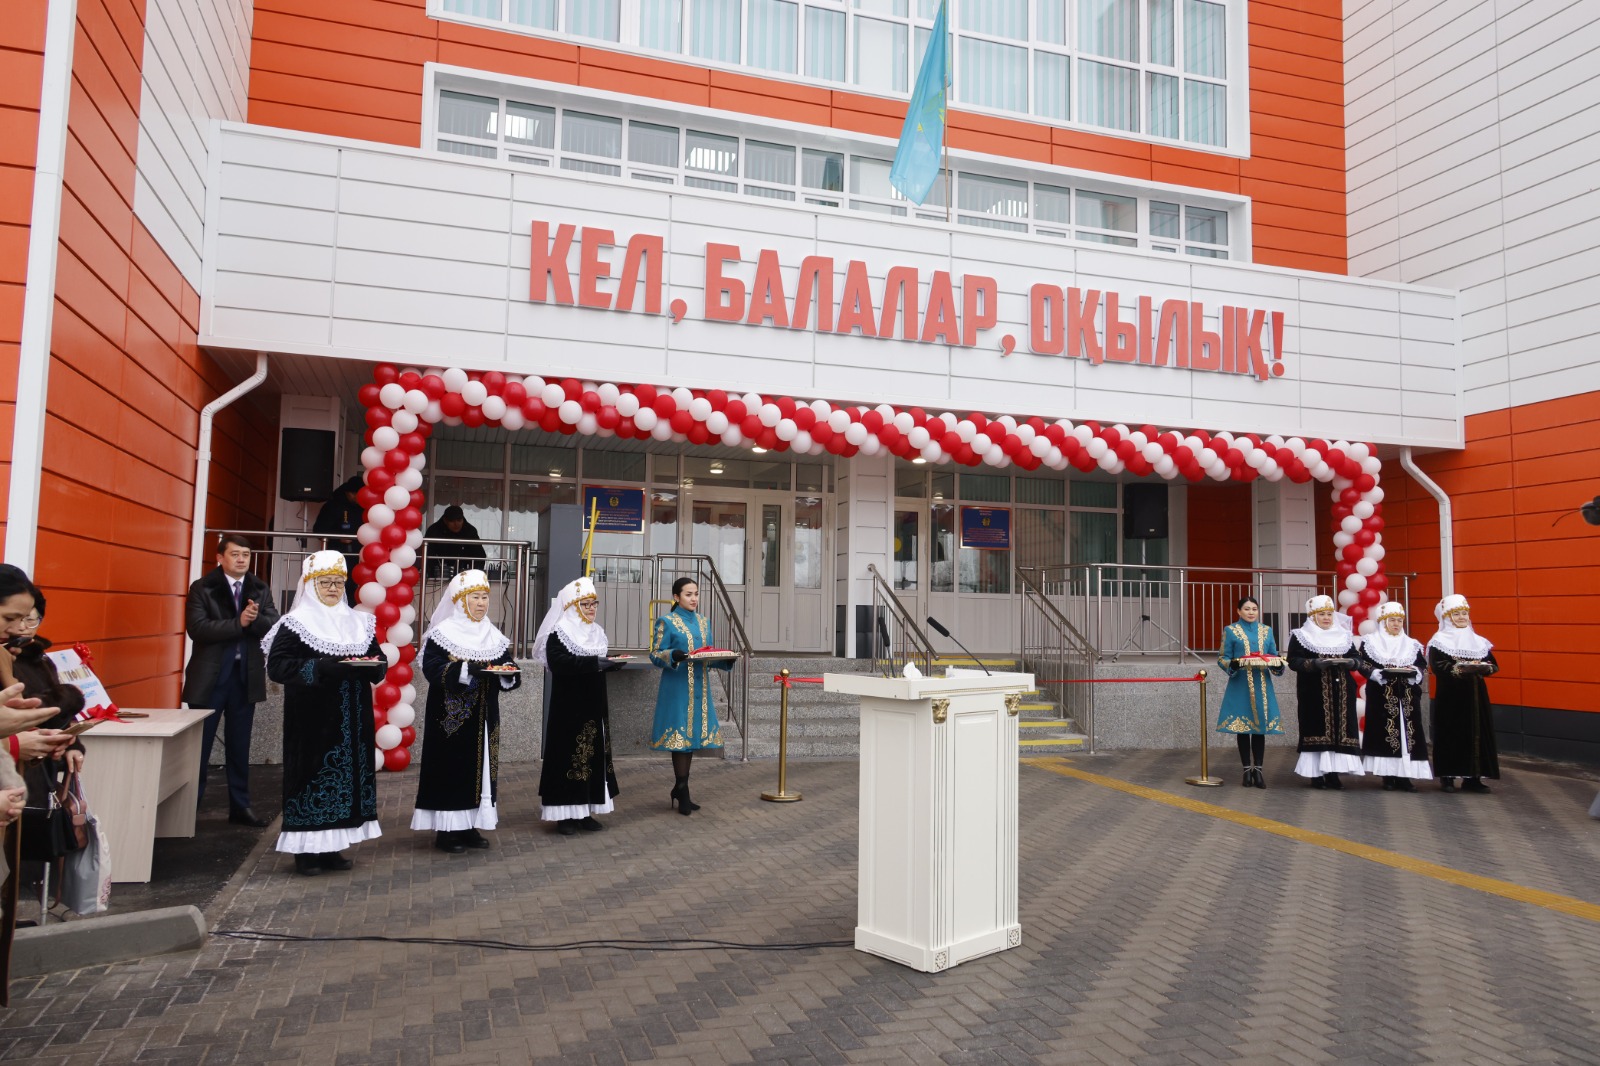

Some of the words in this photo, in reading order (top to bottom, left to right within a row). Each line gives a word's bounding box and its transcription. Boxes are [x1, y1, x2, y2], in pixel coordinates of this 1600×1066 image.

[529, 220, 688, 324] КЕЛ,
[704, 241, 1016, 357] БАЛАЛАР,
[1028, 282, 1285, 382] ОҚЫЛЫҚ!
